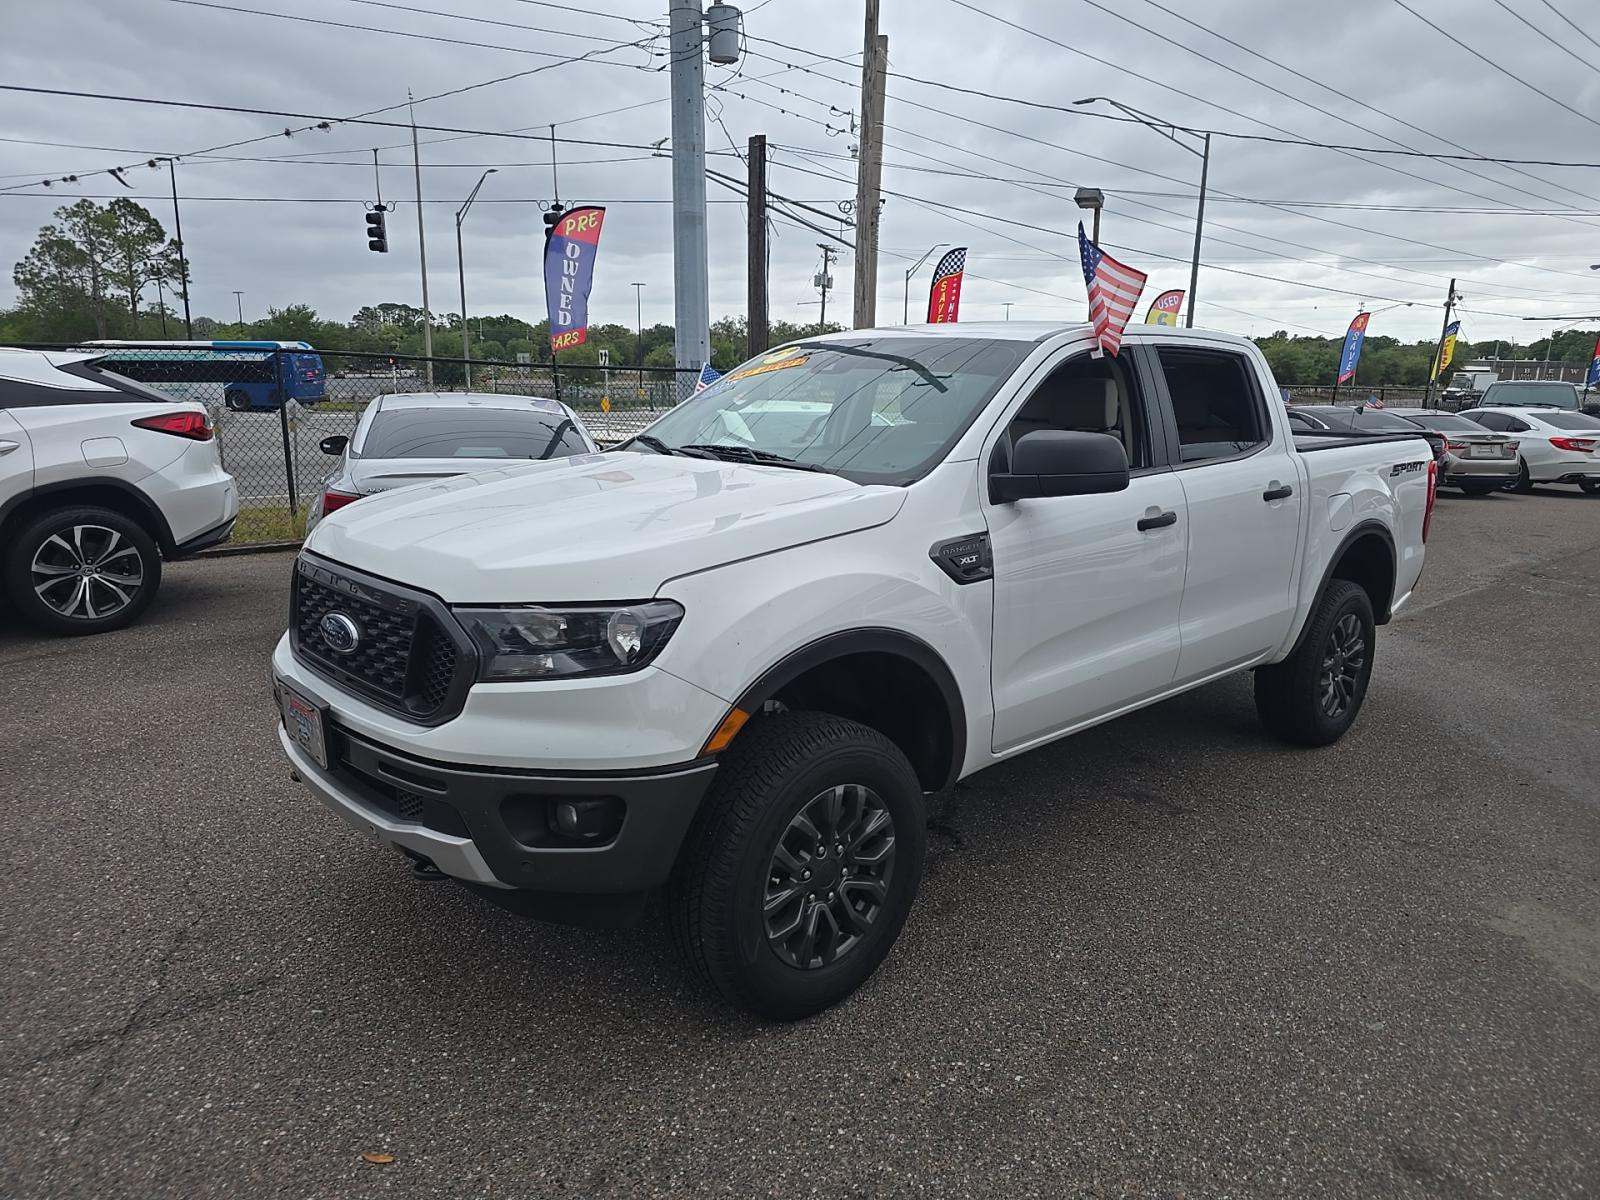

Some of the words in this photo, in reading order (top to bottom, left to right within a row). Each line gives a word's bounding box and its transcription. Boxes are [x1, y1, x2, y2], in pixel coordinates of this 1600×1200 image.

[564, 211, 599, 236] PRE
[558, 241, 581, 326] OWNED
[1157, 295, 1179, 310] USED
[1345, 331, 1360, 371] SAVE
[1390, 461, 1425, 477] SPORT
[960, 555, 978, 565] XLT
